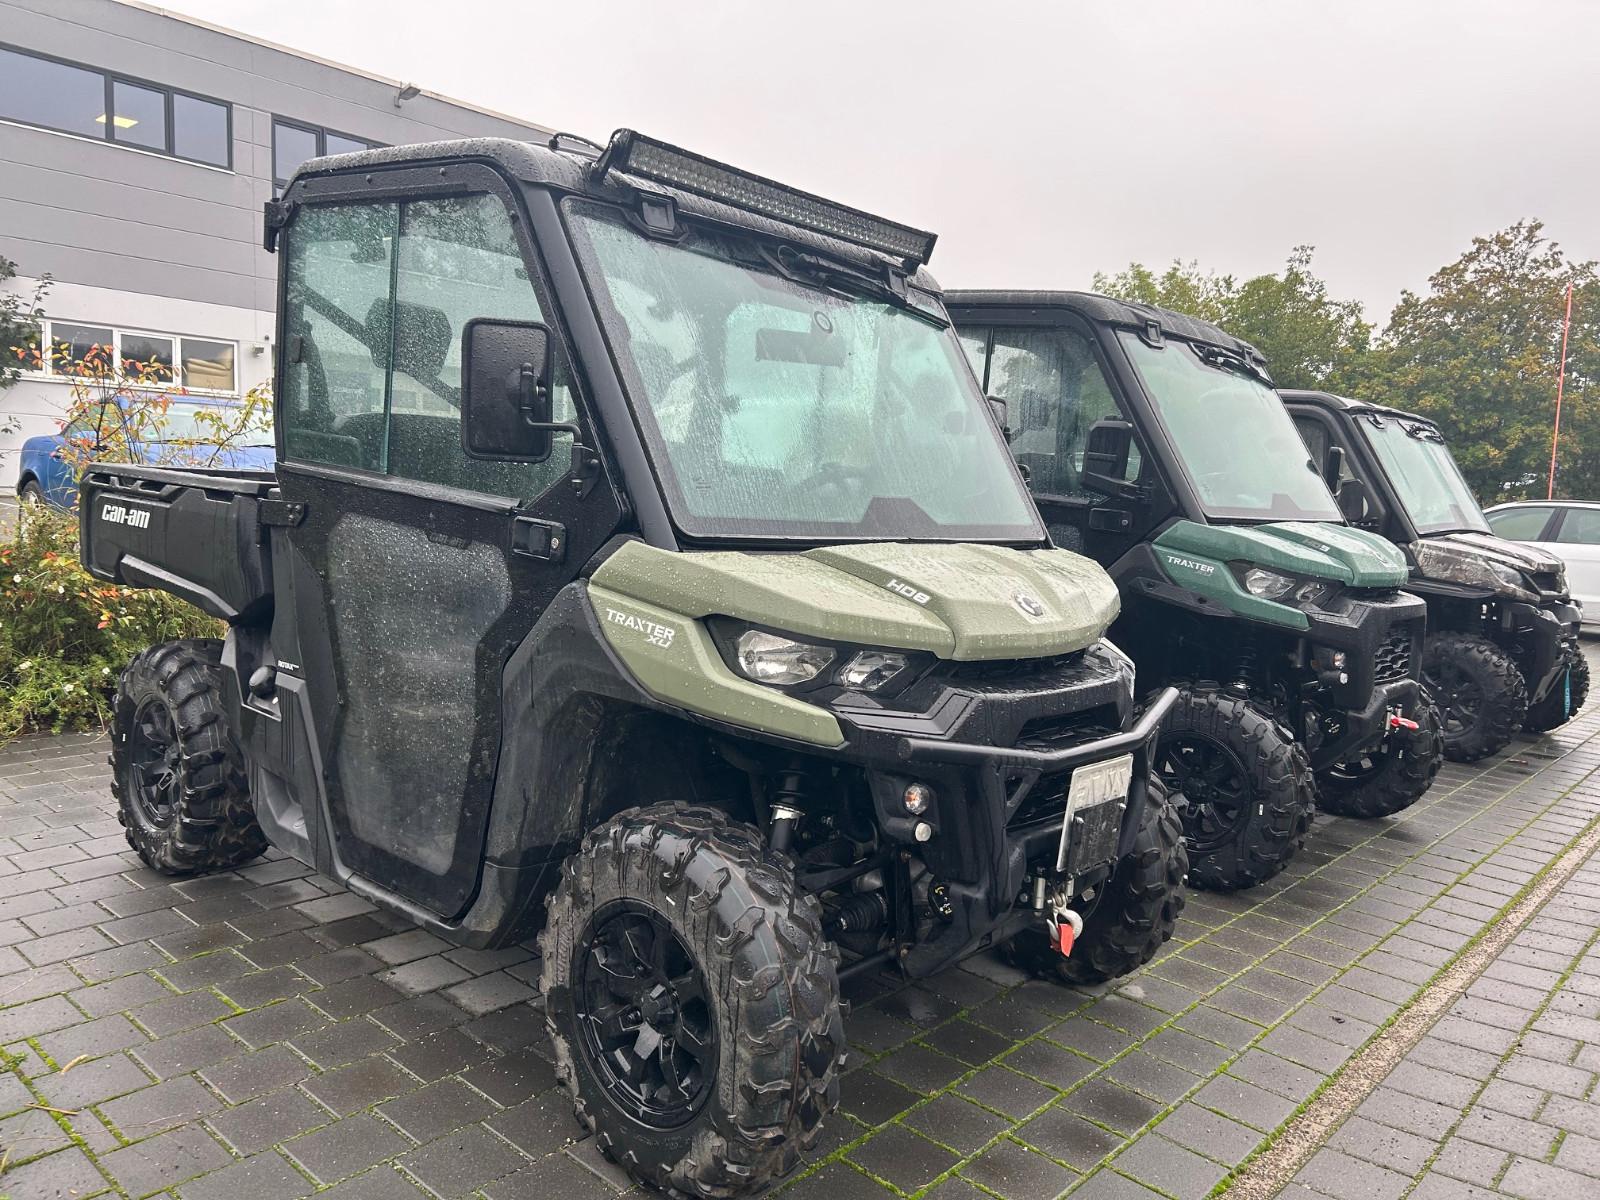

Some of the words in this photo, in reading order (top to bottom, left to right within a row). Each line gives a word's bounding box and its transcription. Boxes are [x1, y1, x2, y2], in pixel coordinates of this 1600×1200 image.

[101, 504, 151, 529] can-am
[1167, 555, 1215, 574] TRAXTER
[886, 578, 931, 604] HD8
[605, 608, 676, 641] TRAXTER
